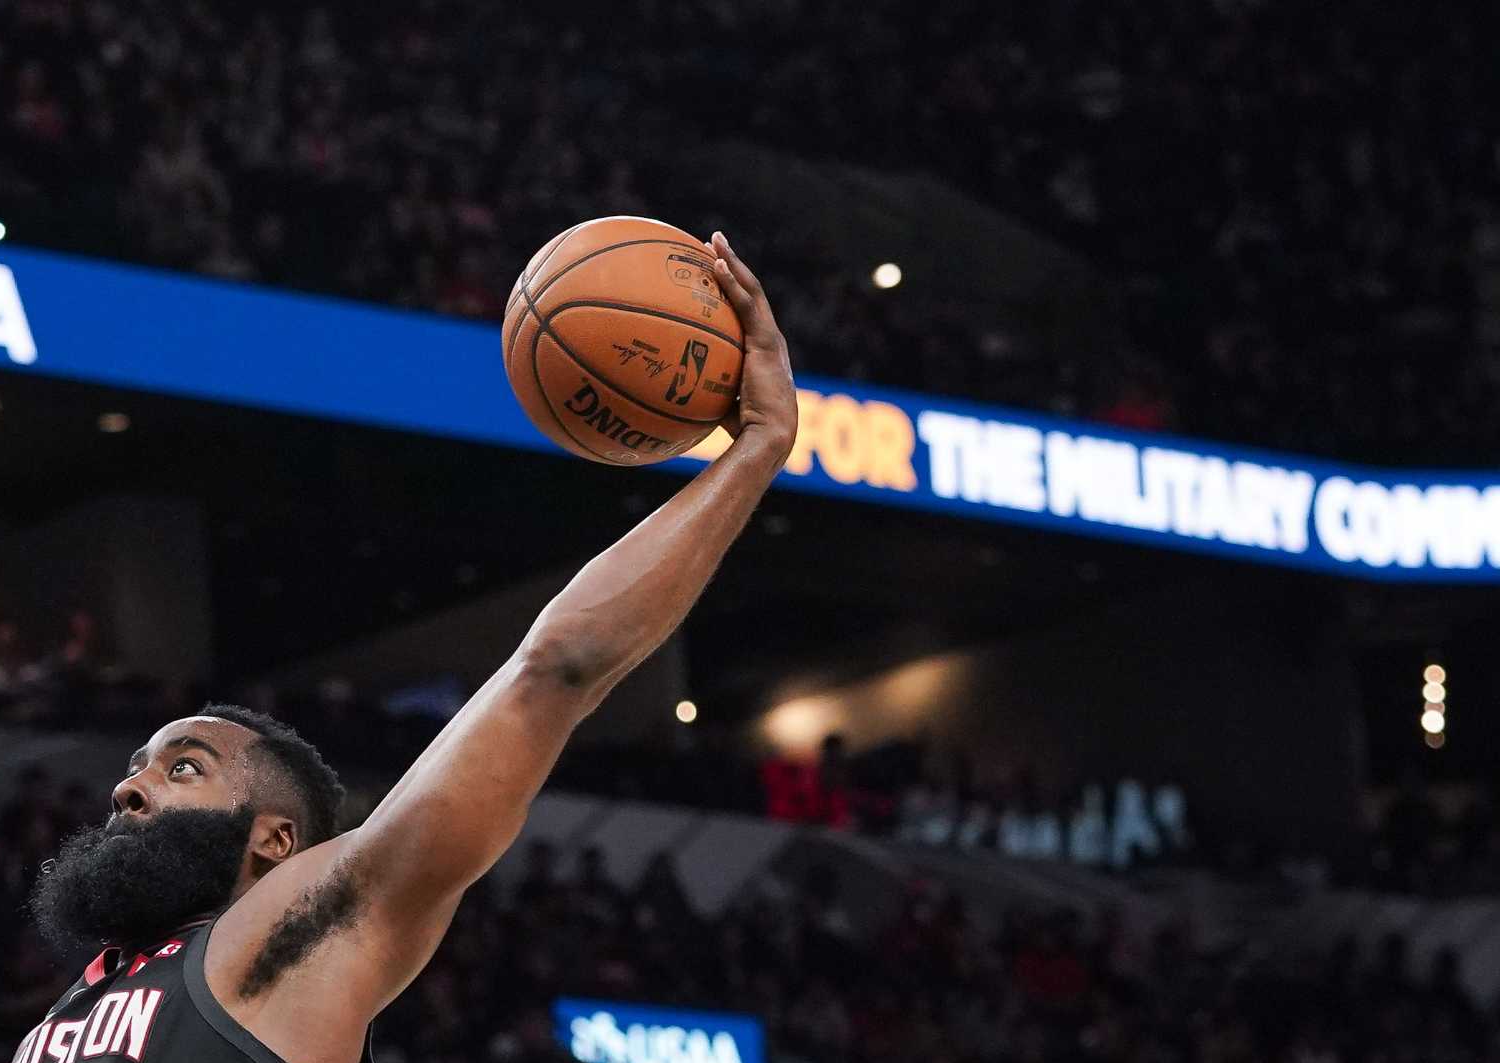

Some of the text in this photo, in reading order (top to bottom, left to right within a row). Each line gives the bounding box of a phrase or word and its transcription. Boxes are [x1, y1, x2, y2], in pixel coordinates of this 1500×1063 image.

[563, 381, 686, 453] LDING
[786, 388, 918, 492] FOR
[917, 410, 1047, 513] THE
[1045, 430, 1316, 554] MILITARY
